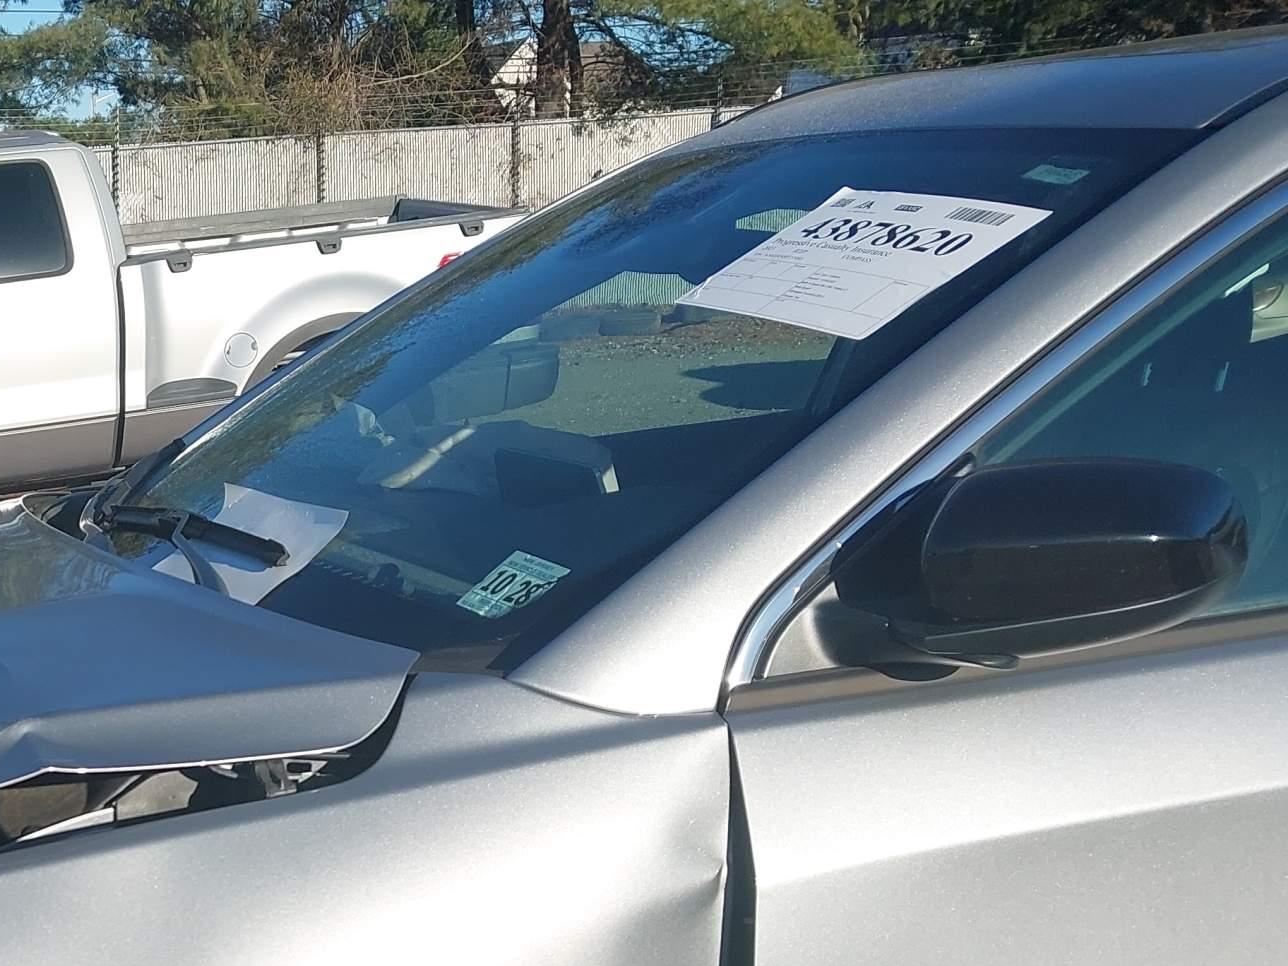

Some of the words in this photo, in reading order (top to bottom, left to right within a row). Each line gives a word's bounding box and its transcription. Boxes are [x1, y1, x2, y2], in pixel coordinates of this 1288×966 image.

[801, 217, 974, 257] 43878620
[850, 246, 893, 257] Insurance
[479, 569, 518, 595] 10
